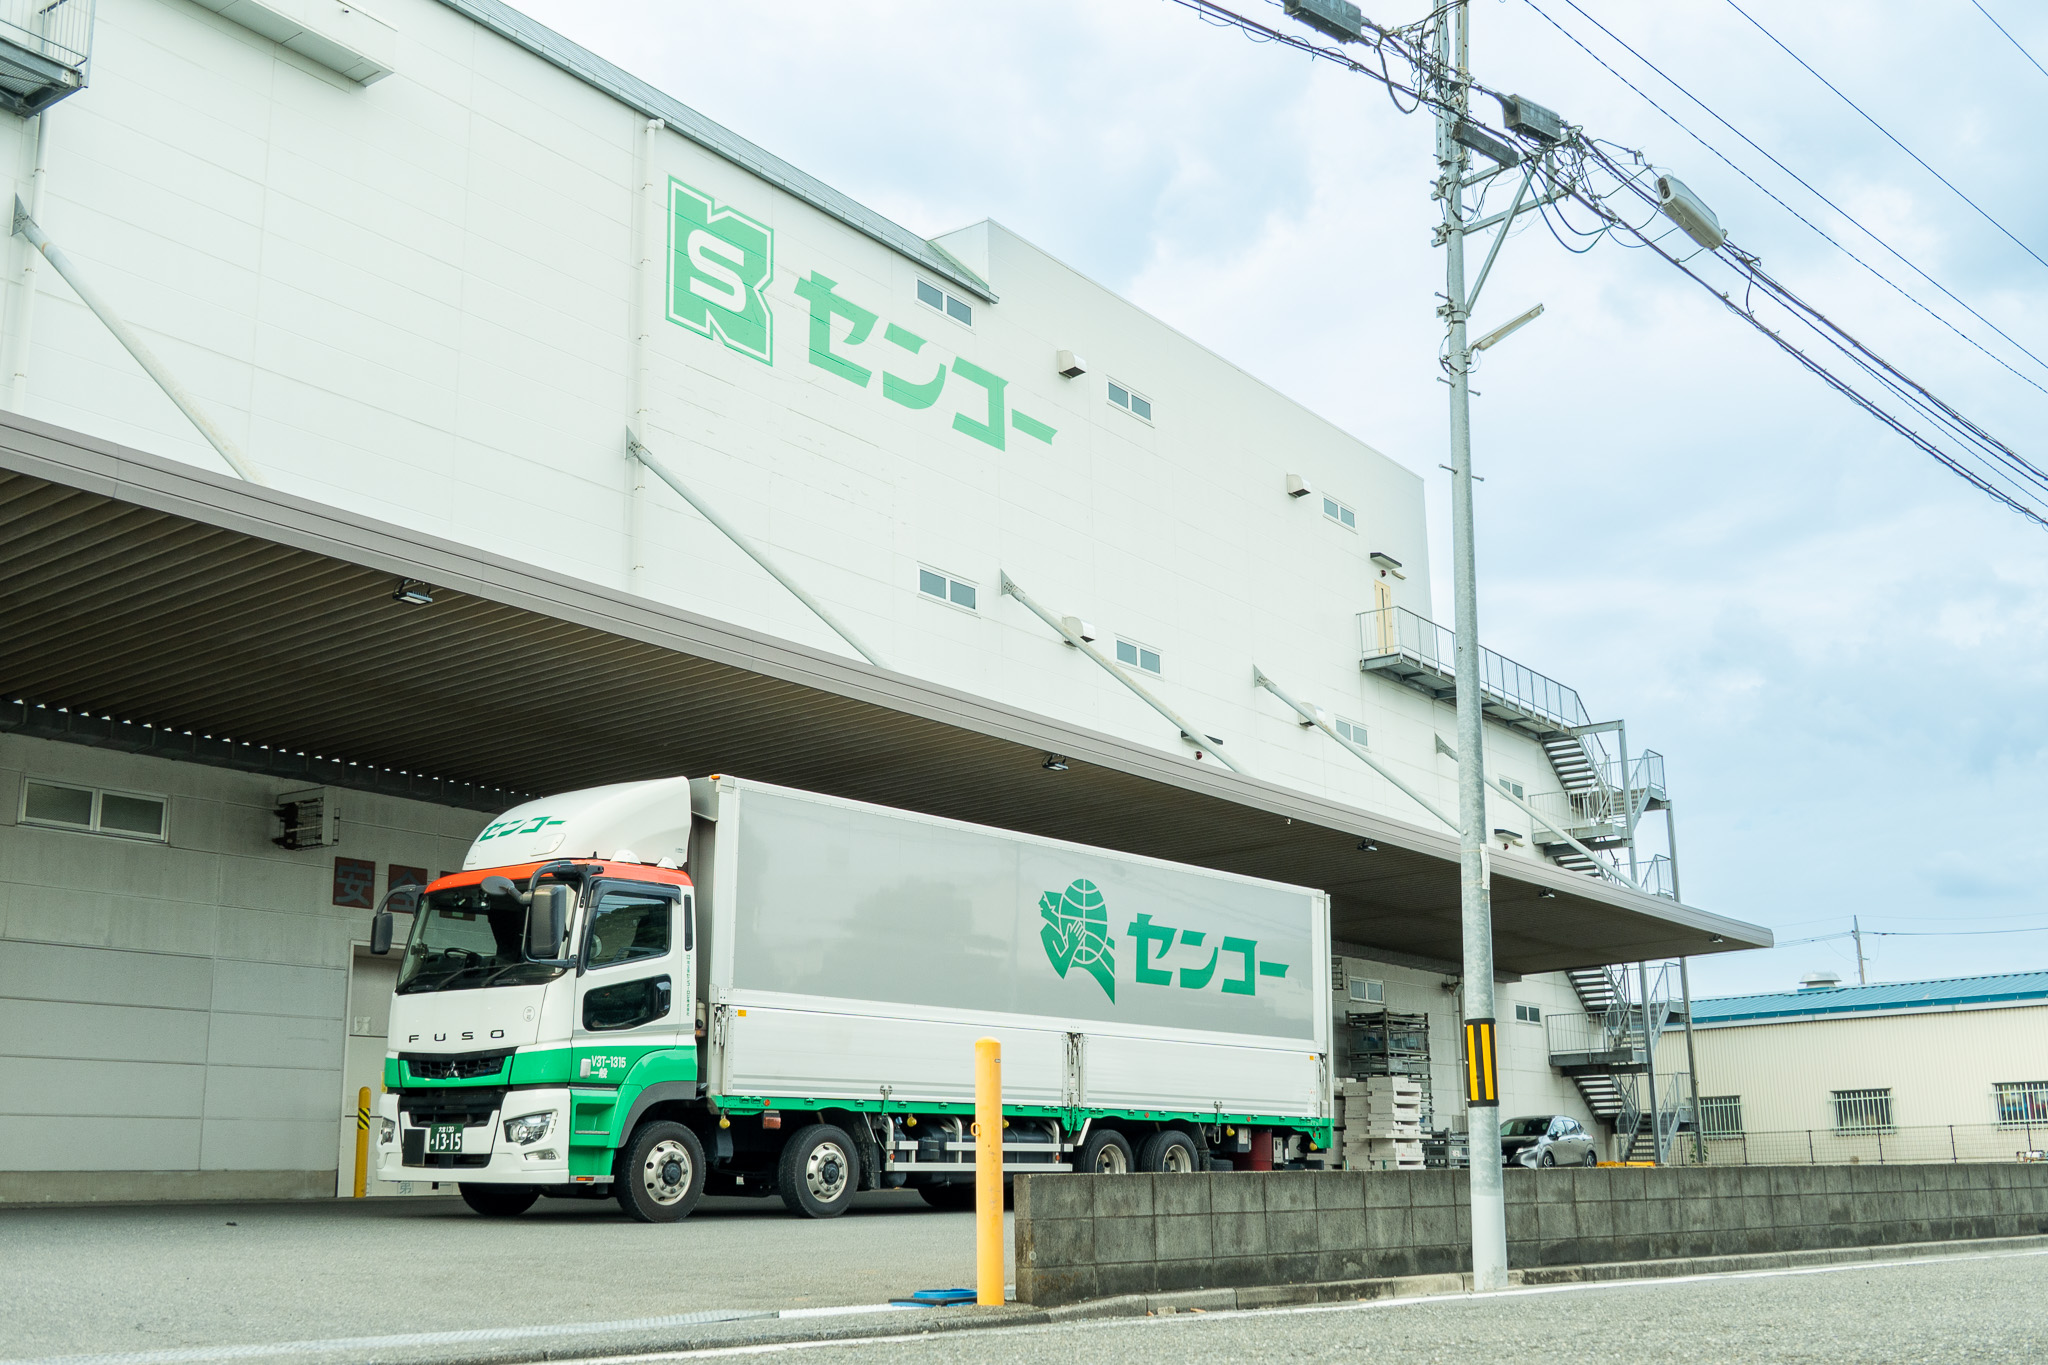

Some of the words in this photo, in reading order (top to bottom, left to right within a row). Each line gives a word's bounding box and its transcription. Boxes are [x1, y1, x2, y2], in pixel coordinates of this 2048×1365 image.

[793, 269, 1058, 453] センコー
[478, 815, 567, 842] センコー
[1126, 912, 1290, 997] センコー
[408, 1029, 505, 1044] FUSO
[591, 1054, 627, 1069] V3T-1315
